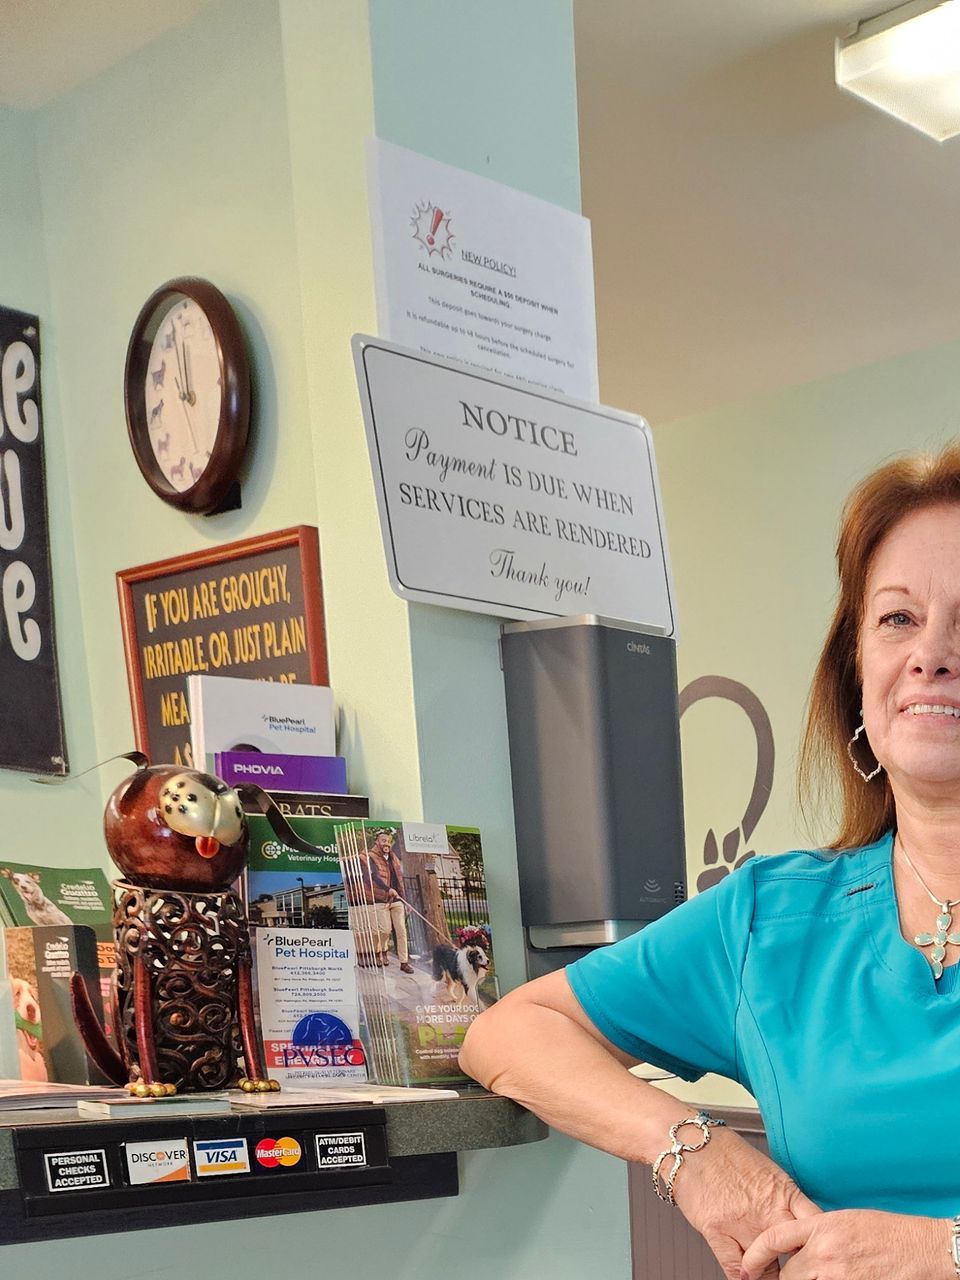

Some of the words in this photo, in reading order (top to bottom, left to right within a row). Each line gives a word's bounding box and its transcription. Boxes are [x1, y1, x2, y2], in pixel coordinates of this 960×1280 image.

[461, 249, 482, 266] NEW
[483, 256, 517, 278] POLICY!
[417, 262, 430, 274] ALL
[431, 266, 468, 286] SURGERIES
[469, 278, 497, 297] REQUIRE
[514, 293, 540, 310] DEPOSIT
[541, 302, 559, 316] WHEN
[441, 299, 463, 315] deposit
[464, 307, 477, 319] goes
[478, 311, 501, 326] towards
[501, 318, 514, 330] your
[514, 321, 533, 338] surgery
[418, 314, 450, 331] refundable
[474, 330, 490, 344] hours
[491, 336, 509, 350] before
[509, 341, 519, 352] the
[519, 344, 547, 361] scheduled
[547, 352, 567, 368] surgery
[459, 400, 578, 456] NOTICE
[404, 427, 497, 483] Payment
[502, 463, 523, 487] IS
[528, 470, 568, 500] DUE
[572, 482, 634, 516] WHEN
[399, 482, 505, 526] SERVICES
[512, 509, 552, 537] ARE
[555, 518, 652, 559] RENDERED
[489, 548, 549, 588] Thank
[554, 576, 592, 602] you!
[144, 592, 158, 633] IF
[160, 587, 190, 626] YOU
[192, 580, 220, 620] ARE
[220, 564, 291, 614] GROUCHY,
[143, 636, 209, 679] IRRITABLE,
[208, 630, 232, 668] OR
[233, 624, 261, 665] JUST
[263, 615, 307, 660] PLAIN
[160, 691, 191, 728] MEA
[269, 715, 306, 725] BluePearl
[269, 723, 283, 732] Pet
[284, 725, 317, 734] Hospital
[233, 763, 285, 775] PHOVIA
[409, 833, 434, 843] Librela
[287, 854, 322, 864] Veterinary
[323, 855, 340, 865] Hosp
[275, 935, 332, 948] BluePearl
[275, 948, 296, 959] Pet
[299, 948, 349, 961] Hospital
[415, 1005, 437, 1014] GIVE
[437, 1004, 462, 1014] YOUR
[416, 1014, 444, 1024] MORE
[445, 1014, 470, 1023] DAYS
[418, 1024, 466, 1048] PLA
[283, 1047, 365, 1068] PVSEC
[318, 1135, 362, 1147] ATM/DEBIT
[131, 1149, 187, 1163] DISCOVER
[255, 1148, 301, 1158] MasterCard
[327, 1145, 356, 1155] CARDS
[51, 1154, 101, 1167] PERSONAL
[206, 1150, 239, 1164] VISA
[320, 1153, 365, 1165] ACCEPTED
[58, 1164, 96, 1176] CHECKS
[147, 1160, 174, 1168] NETWORK
[54, 1174, 103, 1188] ACCEPTED
